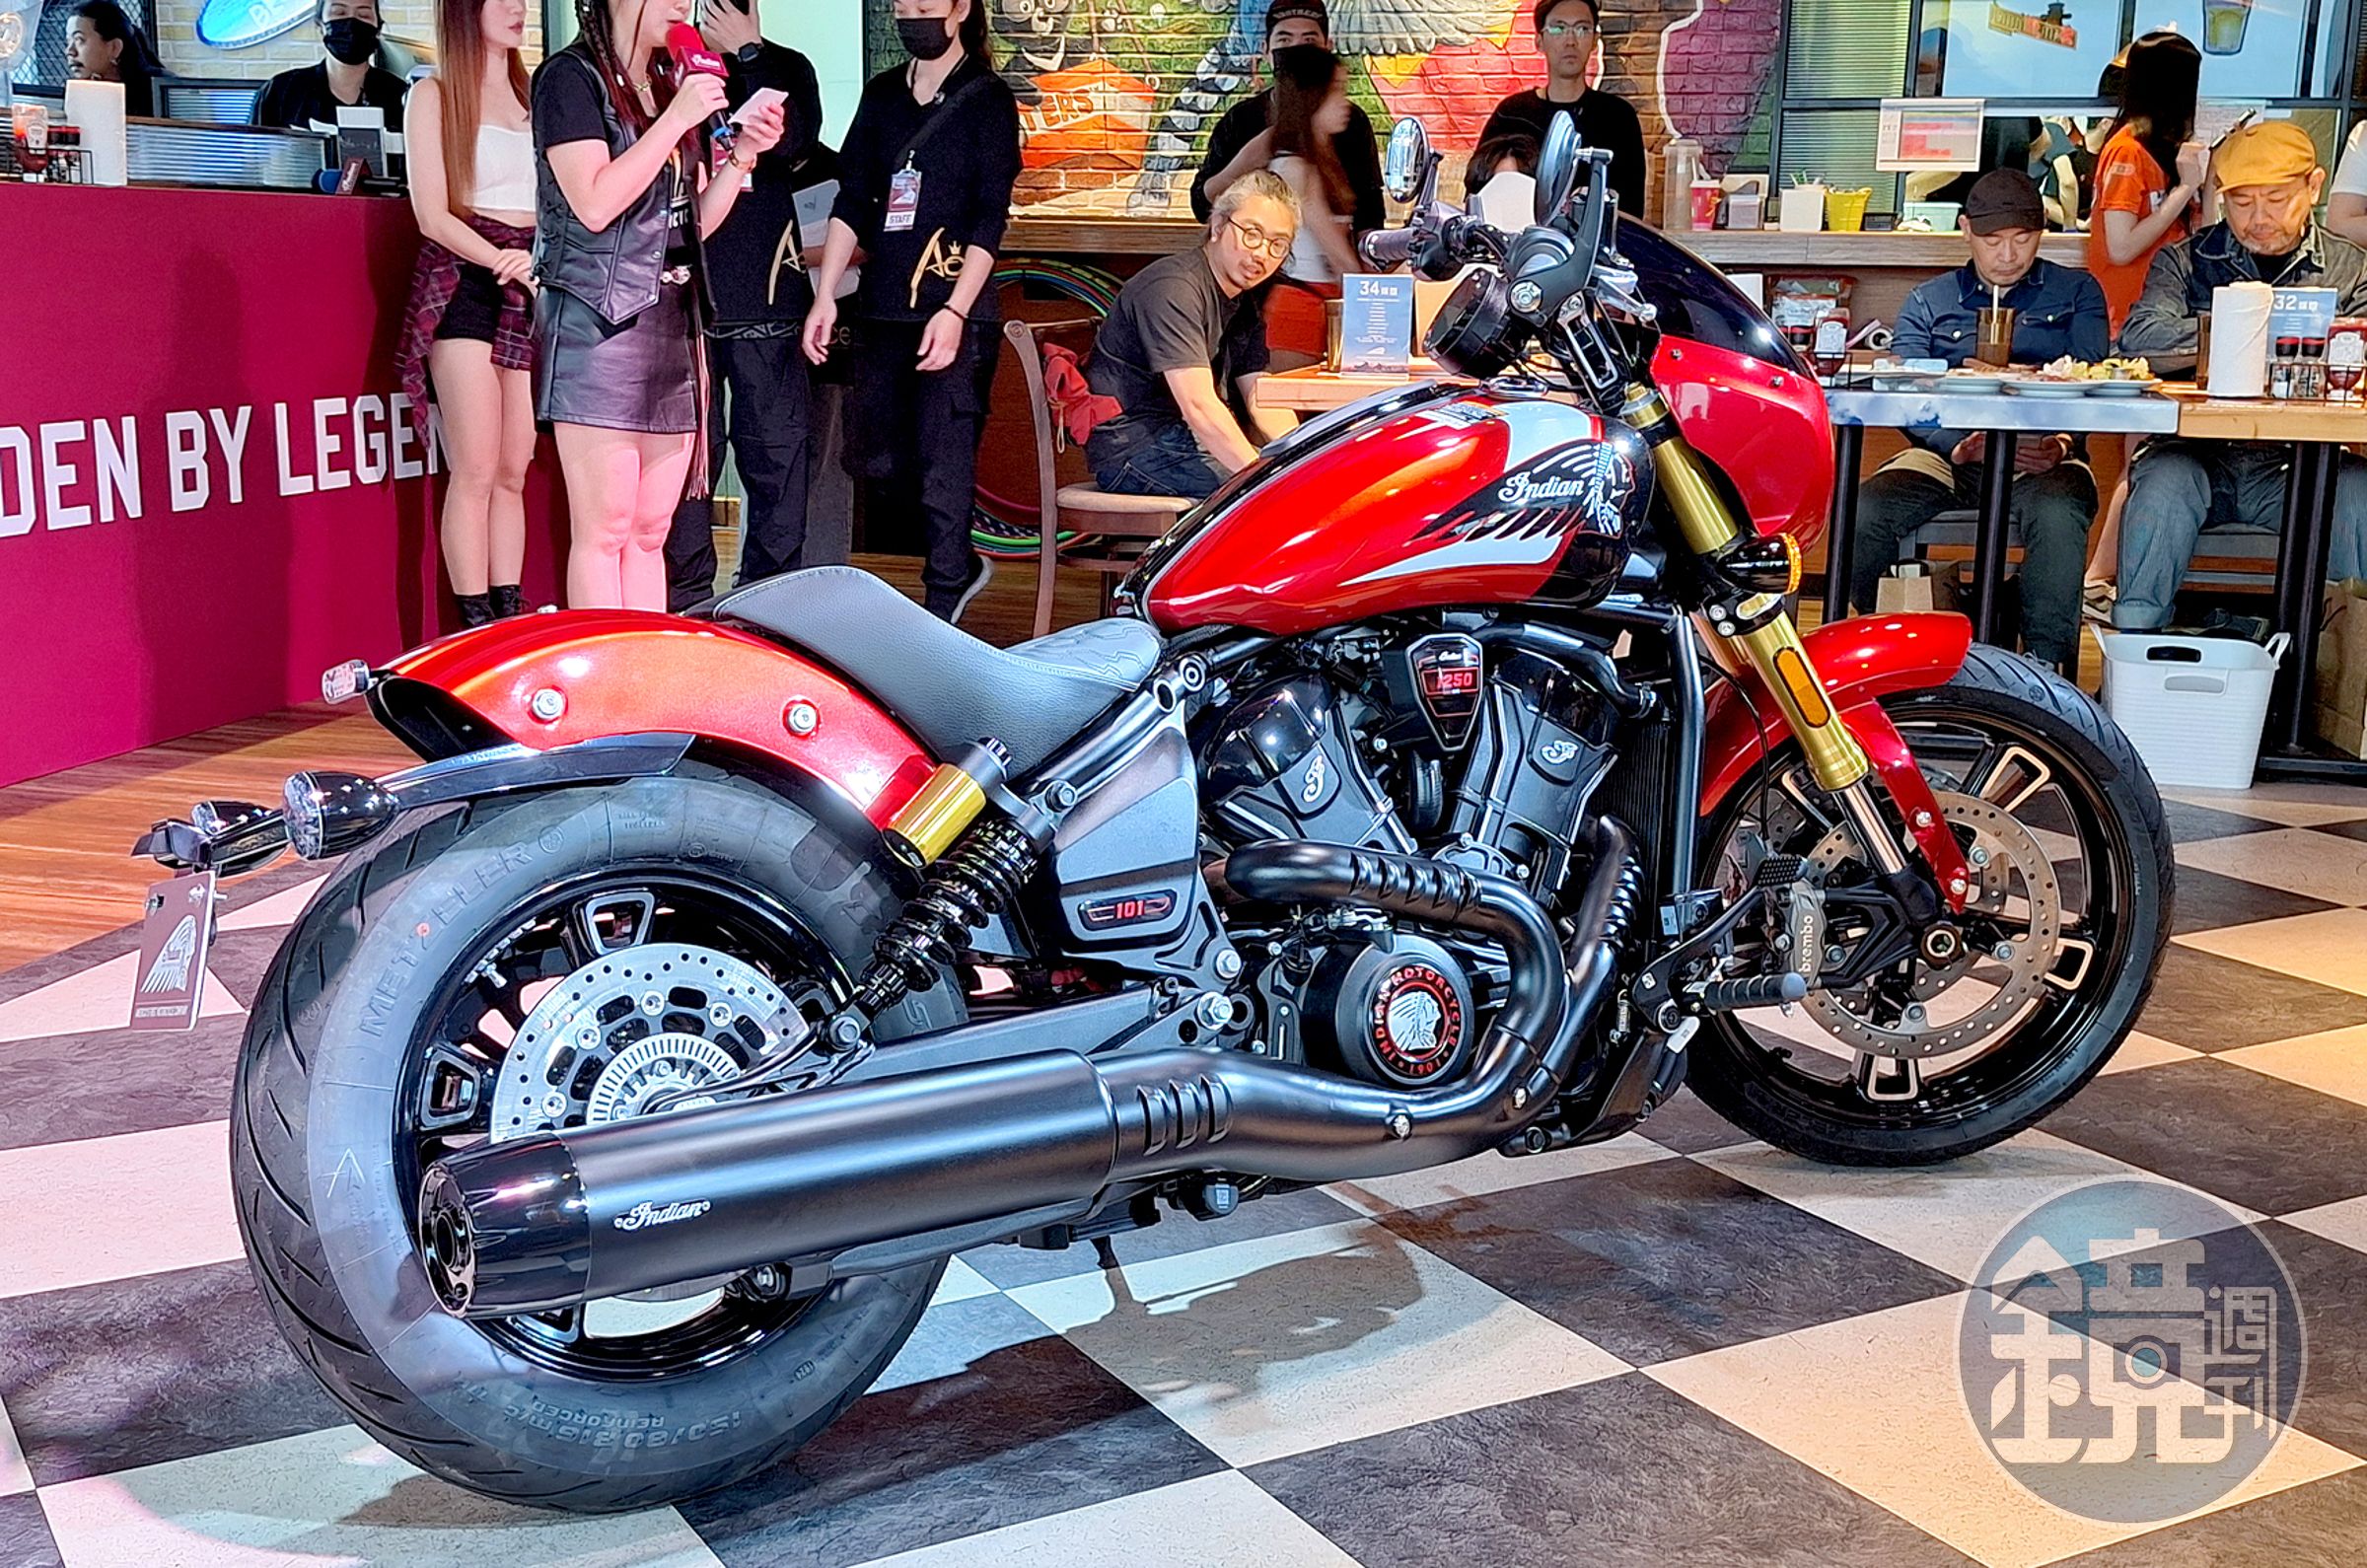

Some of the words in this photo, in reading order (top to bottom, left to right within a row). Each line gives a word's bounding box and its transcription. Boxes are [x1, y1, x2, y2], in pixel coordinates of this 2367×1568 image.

[1359, 281, 1380, 296] 34
[2273, 295, 2297, 310] 32
[166, 405, 252, 512] BY
[1498, 471, 1584, 502] Indian
[1437, 673, 1472, 689] 1250
[1116, 899, 1144, 919] 101
[359, 841, 534, 1037] METZELER
[1798, 915, 1814, 972] brembo
[617, 1201, 706, 1231] Indian
